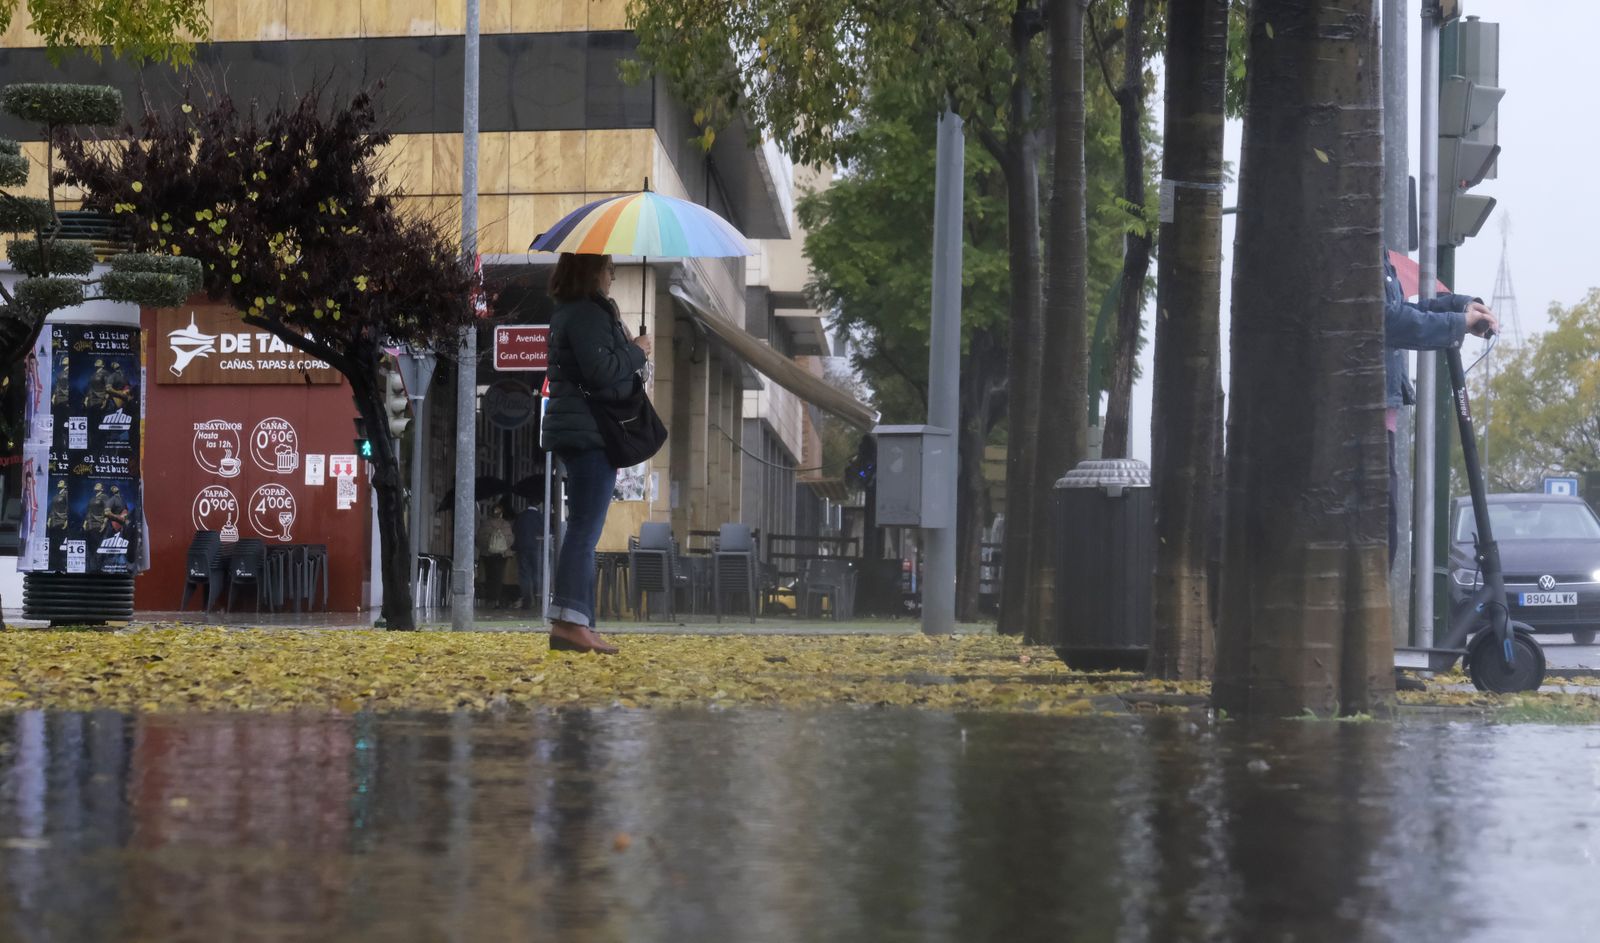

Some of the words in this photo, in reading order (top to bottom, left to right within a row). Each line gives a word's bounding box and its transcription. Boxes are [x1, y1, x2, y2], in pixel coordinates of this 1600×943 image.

[83, 331, 95, 340] el
[515, 334, 545, 343] Avenida
[220, 333, 251, 353] DE
[500, 352, 518, 360] Gran
[219, 358, 255, 371] CAÑAS,
[257, 360, 287, 369] TAPAS
[288, 360, 295, 369] &
[297, 360, 330, 369] COPAS
[70, 422, 87, 431] 16
[260, 420, 288, 430] CAÑAS
[206, 440, 217, 448] las
[219, 440, 233, 448] 12h.
[83, 454, 95, 463] el
[204, 490, 229, 498] TAPAS
[259, 488, 286, 496] COPAS
[68, 545, 85, 554] 16
[1526, 594, 1552, 604] 8904
[1555, 594, 1575, 604] LWK
